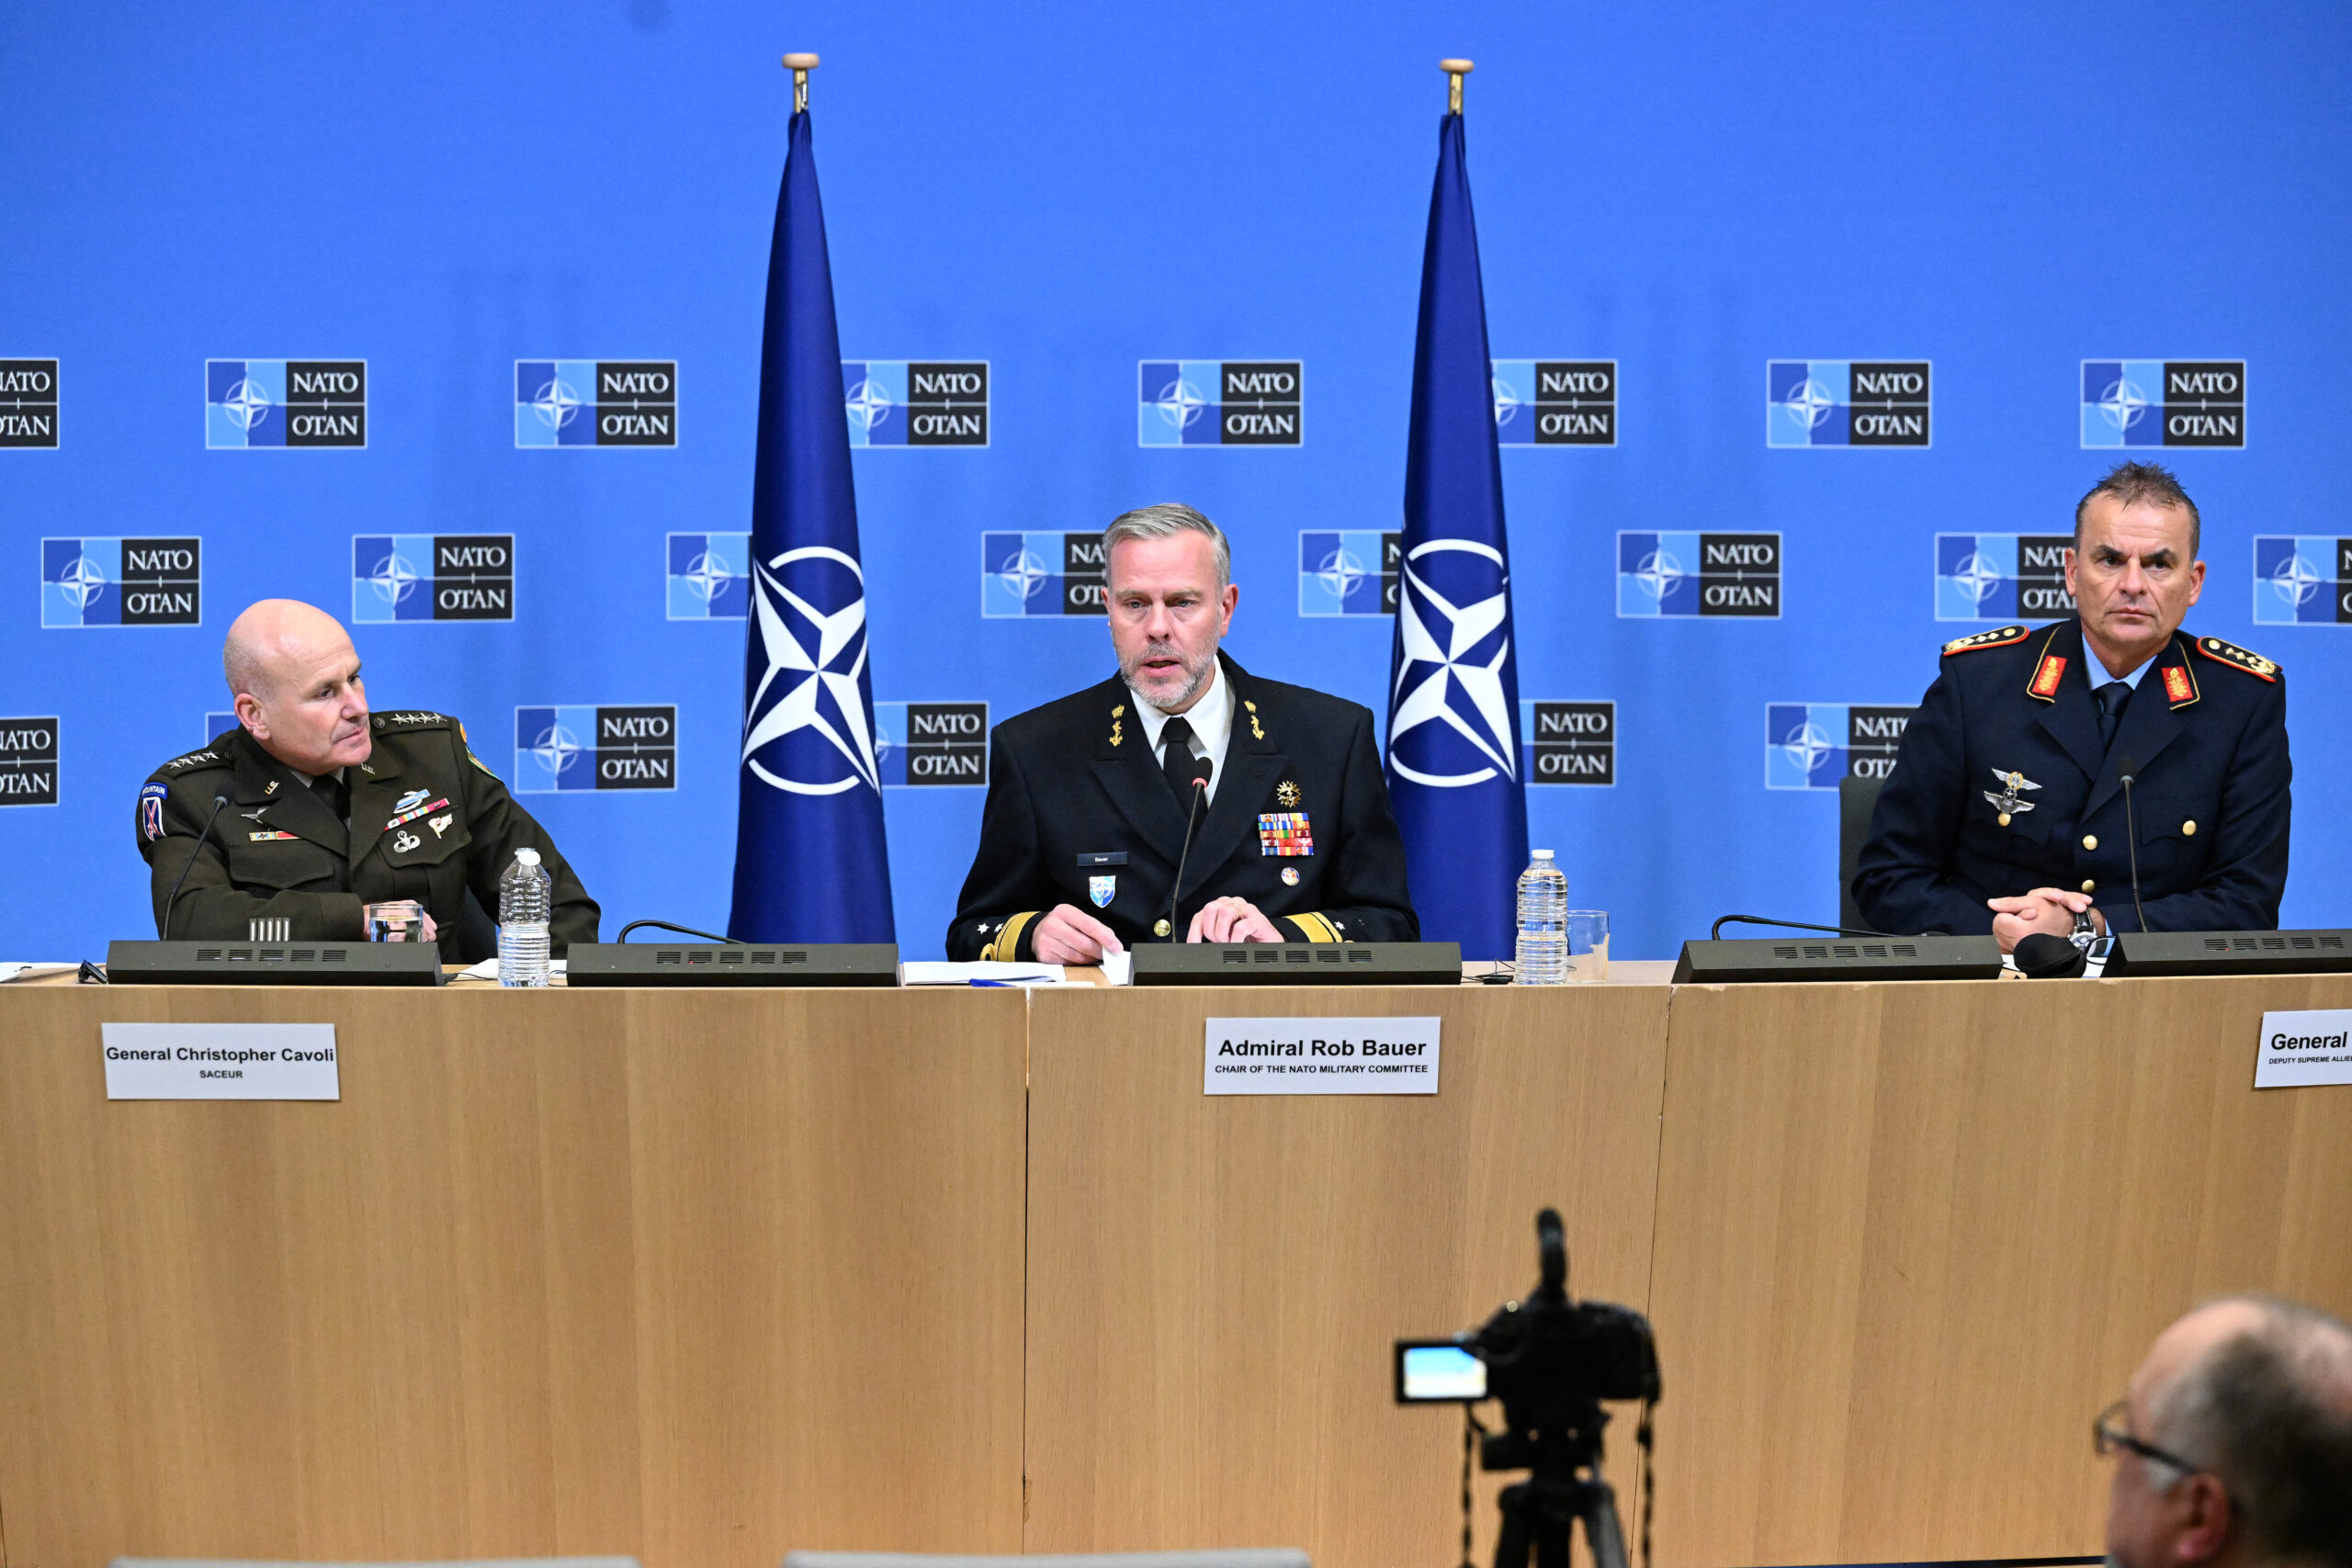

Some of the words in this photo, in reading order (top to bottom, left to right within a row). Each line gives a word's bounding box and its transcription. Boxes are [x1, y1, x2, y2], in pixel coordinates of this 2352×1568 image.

[0, 371, 50, 391] ATO
[294, 373, 358, 392] NATO
[604, 373, 669, 393] NATO
[915, 374, 980, 393] NATO
[1228, 373, 1295, 392] NATO
[1543, 373, 1609, 392] NATO
[1857, 373, 1923, 393] NATO
[2171, 373, 2237, 393] NATO
[0, 415, 50, 435] TAN
[292, 415, 357, 435] OTAN
[602, 415, 668, 434] OTAN
[913, 415, 979, 434] OTAN
[1227, 414, 1293, 434] OTAN
[1541, 414, 1607, 434] OTAN
[1855, 415, 1921, 435] OTAN
[2169, 416, 2236, 435] OTAN
[129, 550, 192, 570] NATO
[441, 547, 505, 567] NATO
[1071, 543, 1105, 564] NA
[1707, 545, 1773, 564] NATO
[2024, 547, 2066, 567] NAT
[128, 593, 191, 614] OTAN
[440, 590, 504, 609] OTAN
[1069, 584, 1103, 605] OT
[1705, 586, 1772, 605] OTAN
[2023, 588, 2076, 609] OTA
[604, 717, 669, 737] NATO
[915, 715, 979, 733] NATO
[1542, 714, 1607, 732] NATO
[1855, 716, 1908, 738] NAT
[0, 730, 51, 750] ATO
[602, 759, 667, 779] OTAN
[912, 756, 978, 774] OTAN
[1539, 754, 1606, 773] OTAN
[0, 773, 50, 794] TAN
[1218, 1039, 1304, 1056] Admiral
[1311, 1039, 1355, 1056] Rob
[1362, 1039, 1427, 1056] Bauer
[2270, 1031, 2348, 1051] General
[106, 1046, 172, 1061] General
[176, 1047, 277, 1065] Christopher
[281, 1048, 334, 1062] Cavoli
[2297, 1055, 2330, 1064] SUPREME
[199, 1070, 243, 1078] SACEUR
[1215, 1065, 1247, 1074] CHAIR
[1249, 1065, 1263, 1074] OF
[1266, 1065, 1286, 1074] THE
[1289, 1065, 1317, 1074] NATO
[1319, 1065, 1366, 1074] MILITARY
[1368, 1065, 1428, 1074] COMMITTEE
